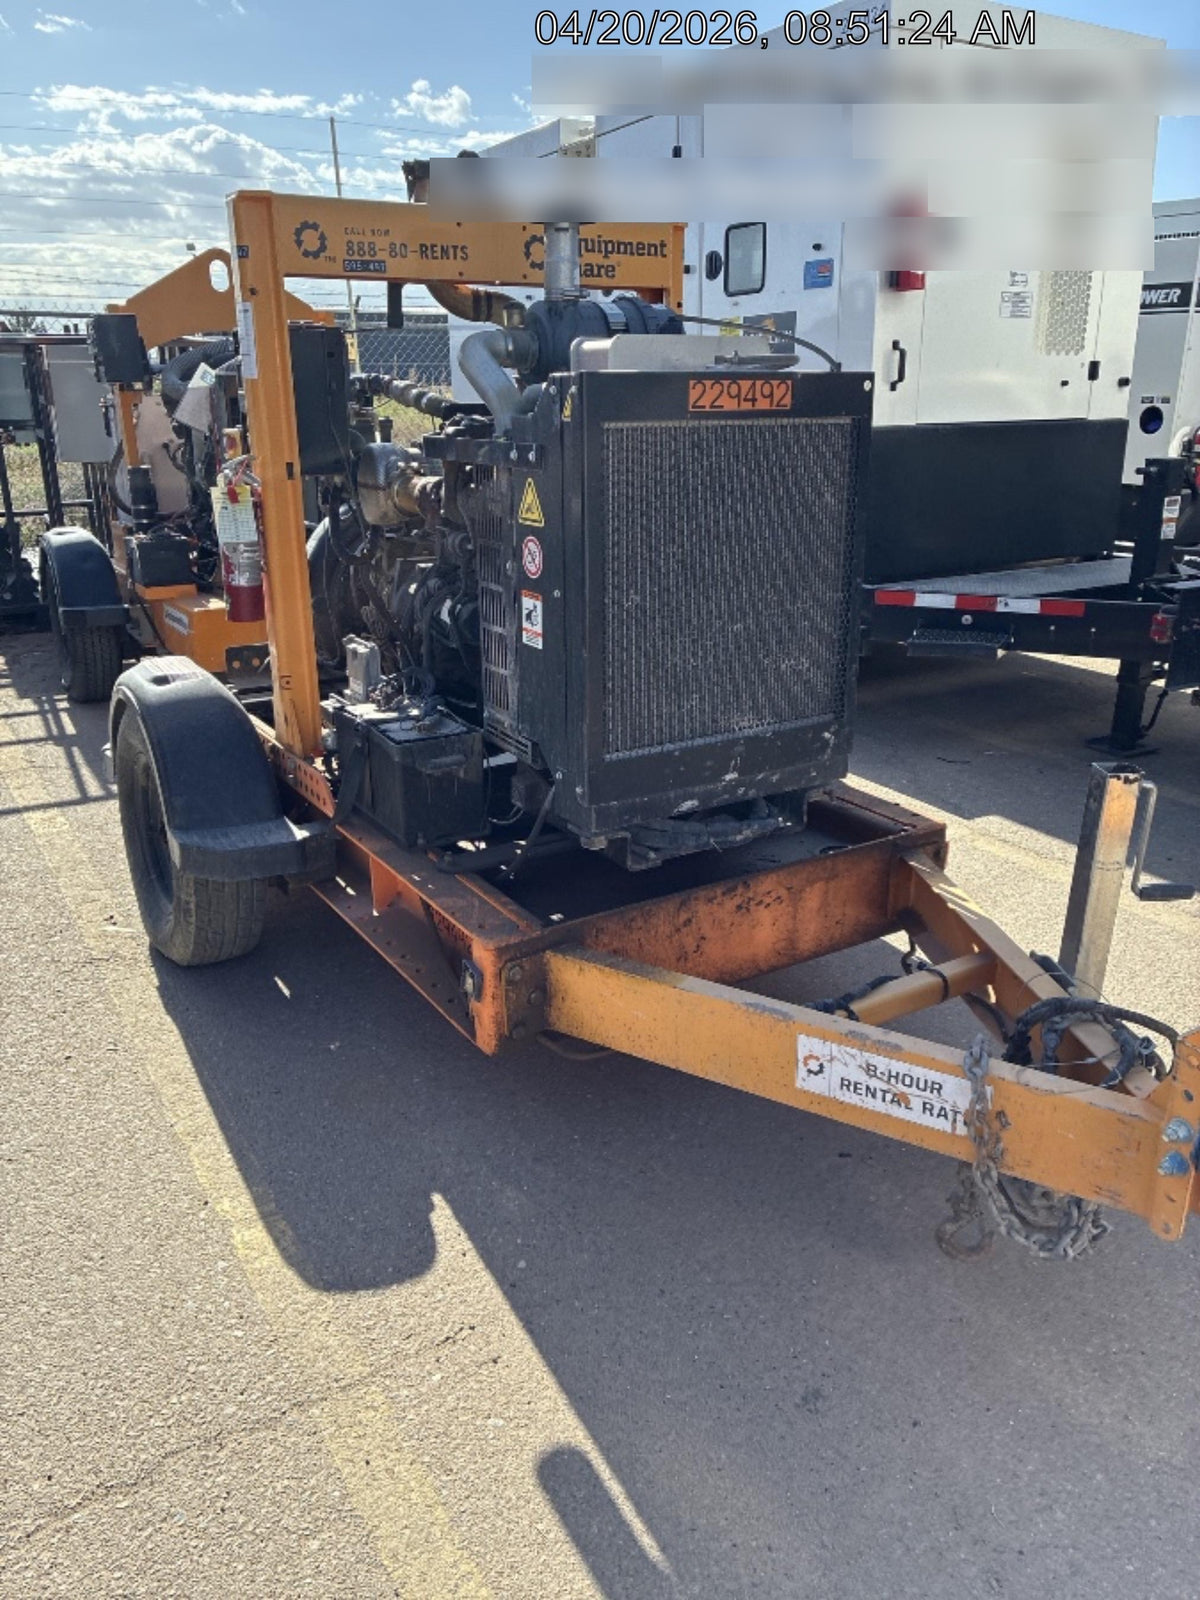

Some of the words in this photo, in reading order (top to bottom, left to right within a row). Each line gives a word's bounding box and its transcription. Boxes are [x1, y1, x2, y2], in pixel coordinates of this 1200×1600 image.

[345, 239, 470, 261] 888-80-RENTS
[578, 261, 617, 279] are
[690, 381, 791, 410] 229492
[921, 1100, 968, 1126] RAT
